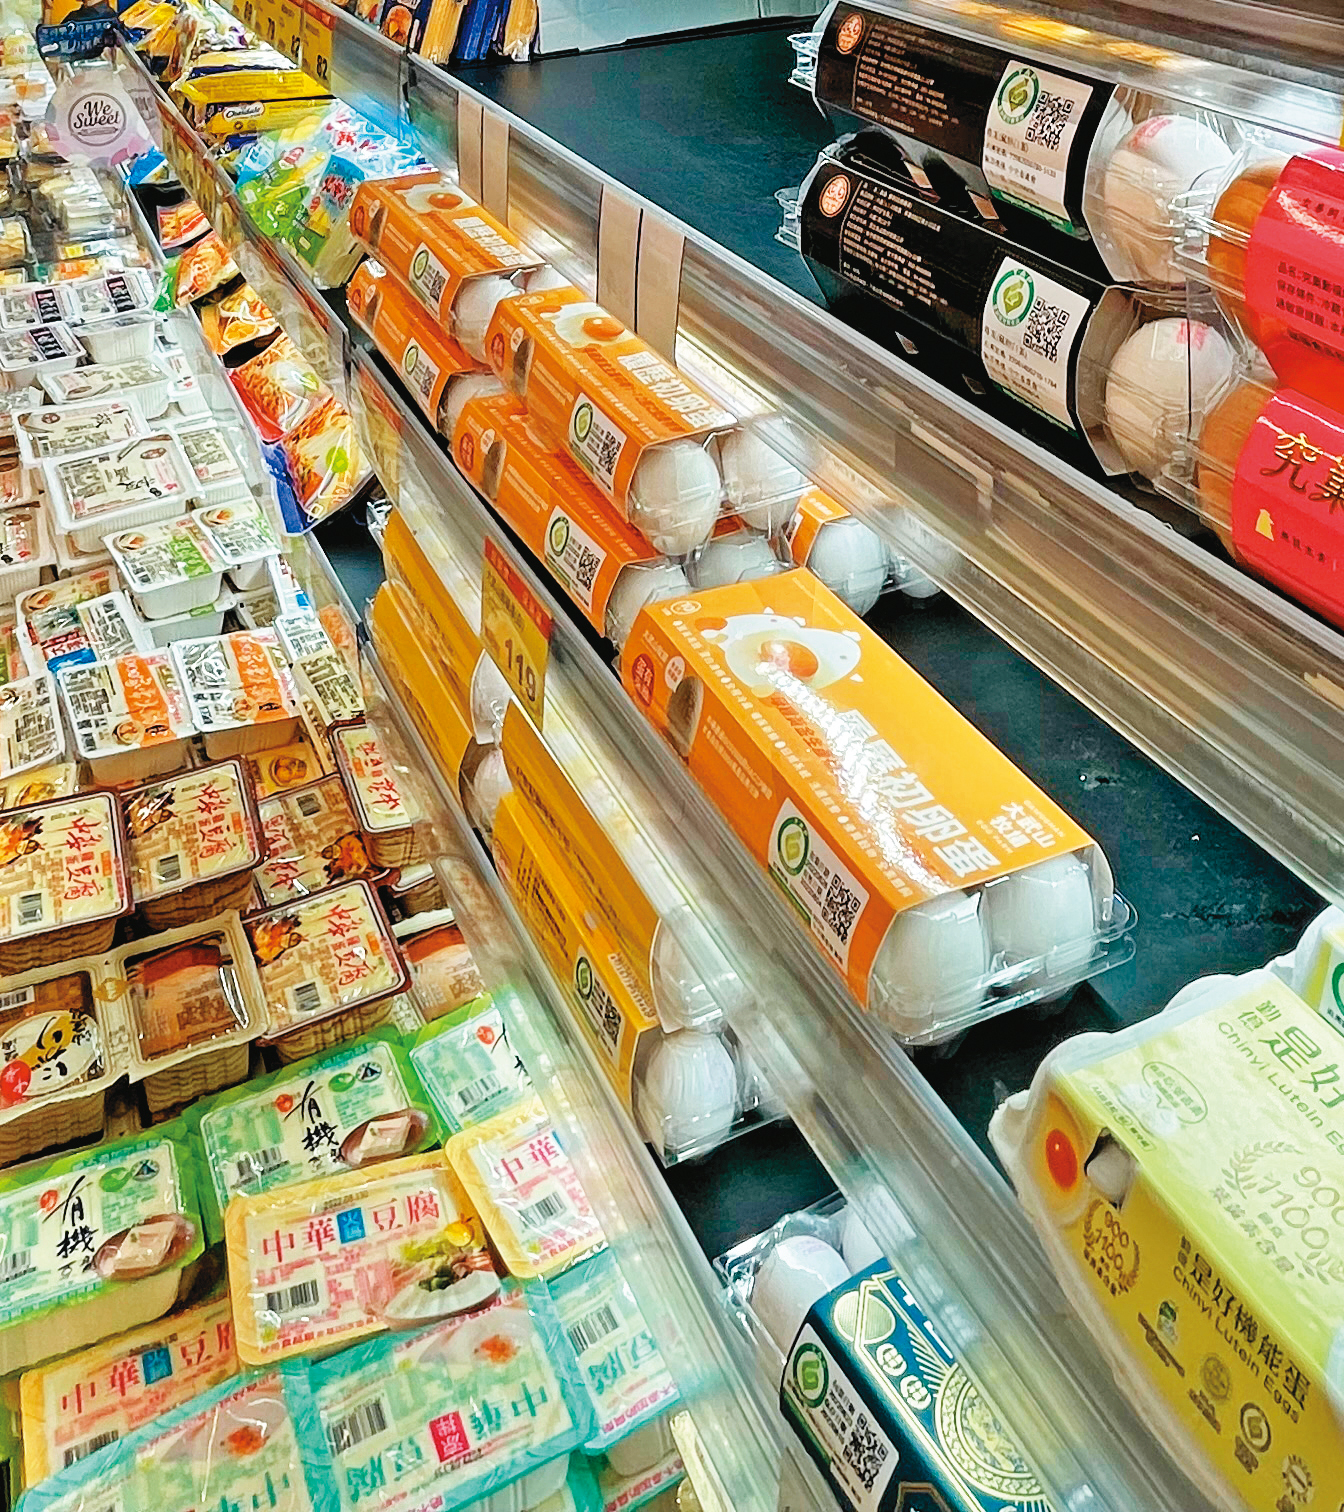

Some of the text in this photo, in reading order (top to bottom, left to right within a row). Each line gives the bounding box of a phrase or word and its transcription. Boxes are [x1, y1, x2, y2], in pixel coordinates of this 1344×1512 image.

[73, 112, 120, 129] Sweet
[83, 100, 112, 117] We
[1217, 1020, 1270, 1072] Chinyi
[1267, 1072, 1324, 1129] Lutein
[1173, 1265, 1212, 1321] Chinyi
[1215, 1317, 1260, 1378] Lutein
